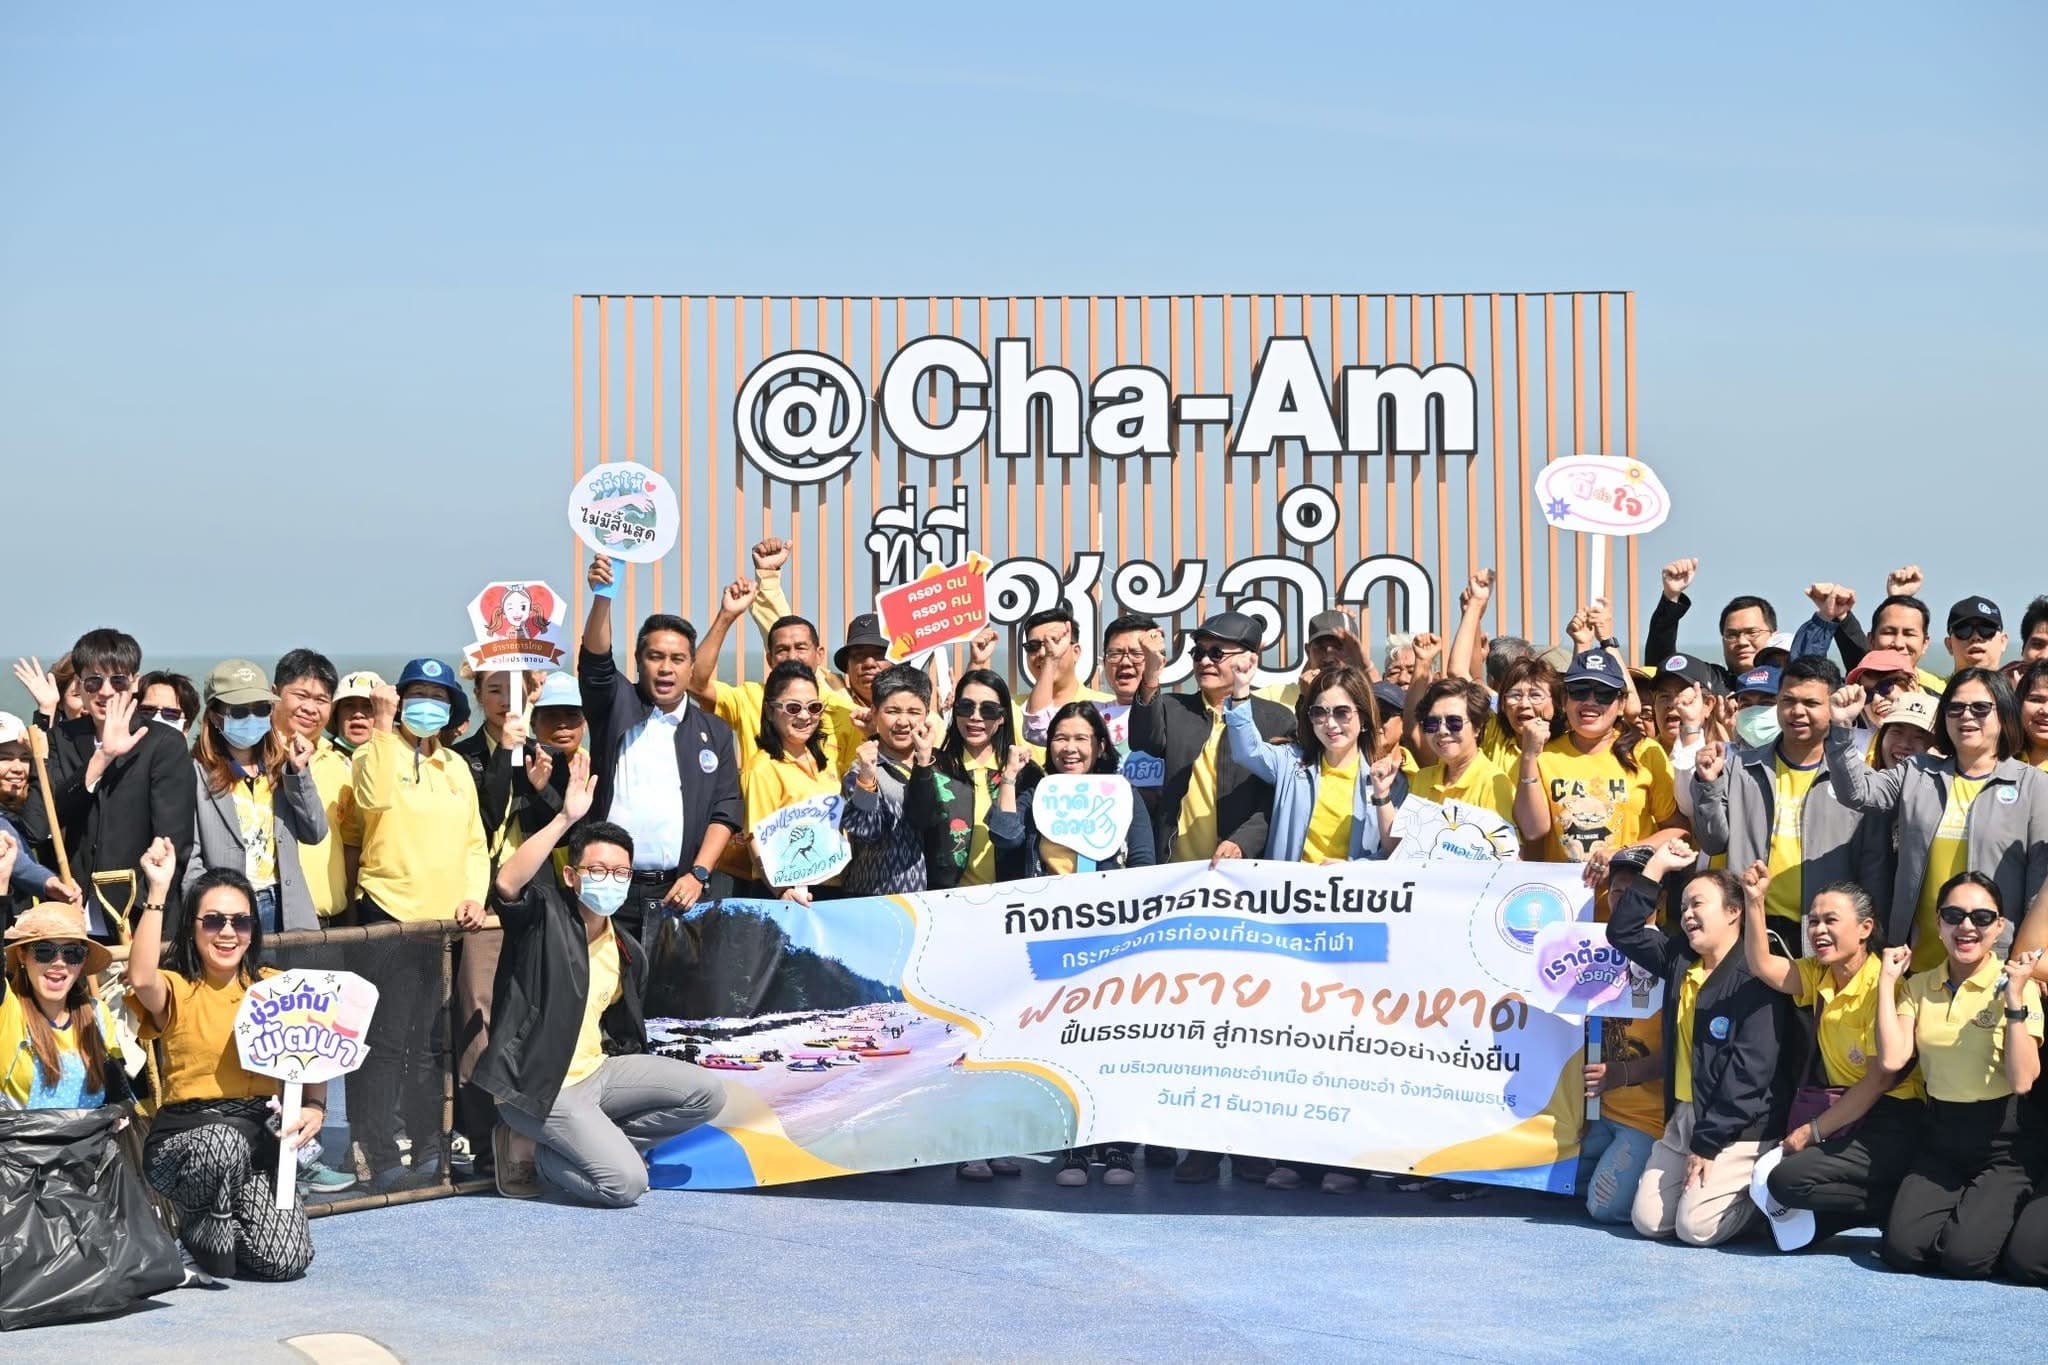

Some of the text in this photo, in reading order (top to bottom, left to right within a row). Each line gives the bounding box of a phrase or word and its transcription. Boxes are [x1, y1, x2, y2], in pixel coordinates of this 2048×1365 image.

[733, 335, 1477, 485] @Cha-Am
[589, 471, 645, 497] พลังให้
[581, 506, 656, 543] ไม่มีสิ้นสุด
[907, 576, 967, 603] ครอง ตน
[987, 483, 1434, 690] ชะอำ
[912, 593, 972, 620] ครอง คน
[915, 610, 982, 637] ครอง งาน
[1119, 760, 1161, 780] าสา
[1042, 782, 1089, 809] ทำดี
[1051, 811, 1096, 835] ด้วย
[1005, 877, 1415, 934] กิจกรรมสาธารณประโยชน์
[1062, 922, 1354, 969] กระทรวงการท่องเที่ยวและกีฬา
[250, 984, 330, 1025] ช่วยกัน
[1018, 971, 1528, 1032] ฟอกทราย ชายหาด
[252, 1021, 358, 1067] พัฒนา
[1060, 1019, 1520, 1072] ฟื้นธรรมชาติ สู่การท่องเที่ยวอย่างยั่งยืน
[1099, 1060, 1517, 1112] ณ บริเวณชายหาดชะอำเหนือ อำเภอชะอำ จังหวัดเพชรบุรี
[1157, 1086, 1351, 1123] วันที่ 21 ธันวาคม 2567
